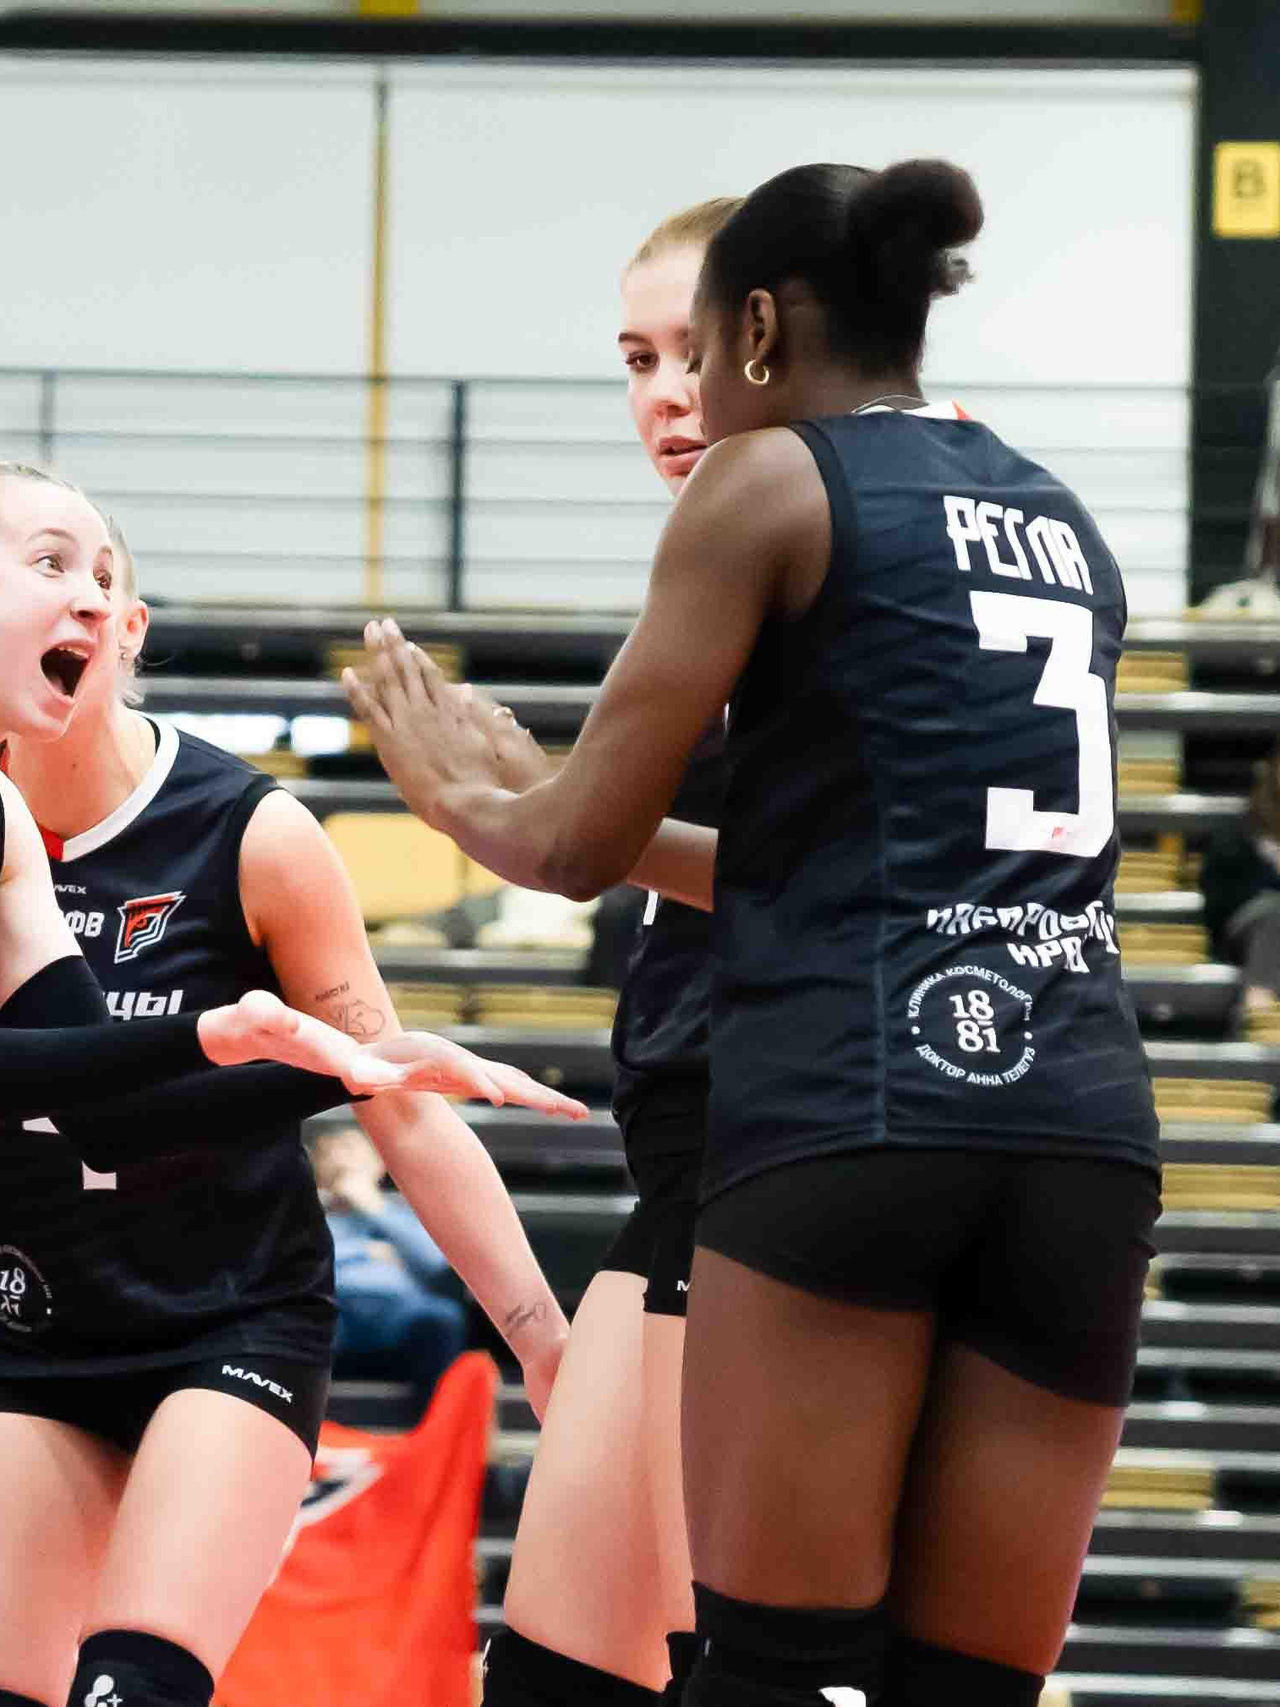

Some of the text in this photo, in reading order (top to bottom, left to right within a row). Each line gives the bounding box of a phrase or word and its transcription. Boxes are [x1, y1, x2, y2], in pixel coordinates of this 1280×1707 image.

[943, 495, 1093, 595] РЕГЛА
[970, 590, 1115, 858] 3
[65, 910, 105, 937] ФВ
[907, 973, 946, 1018] КЛИНИКА
[949, 990, 995, 1021] 18
[956, 1020, 1001, 1053] 81
[915, 1044, 967, 1078] ДОКТОР
[966, 1072, 1004, 1086] АННА
[221, 1364, 293, 1404] MAVEX
